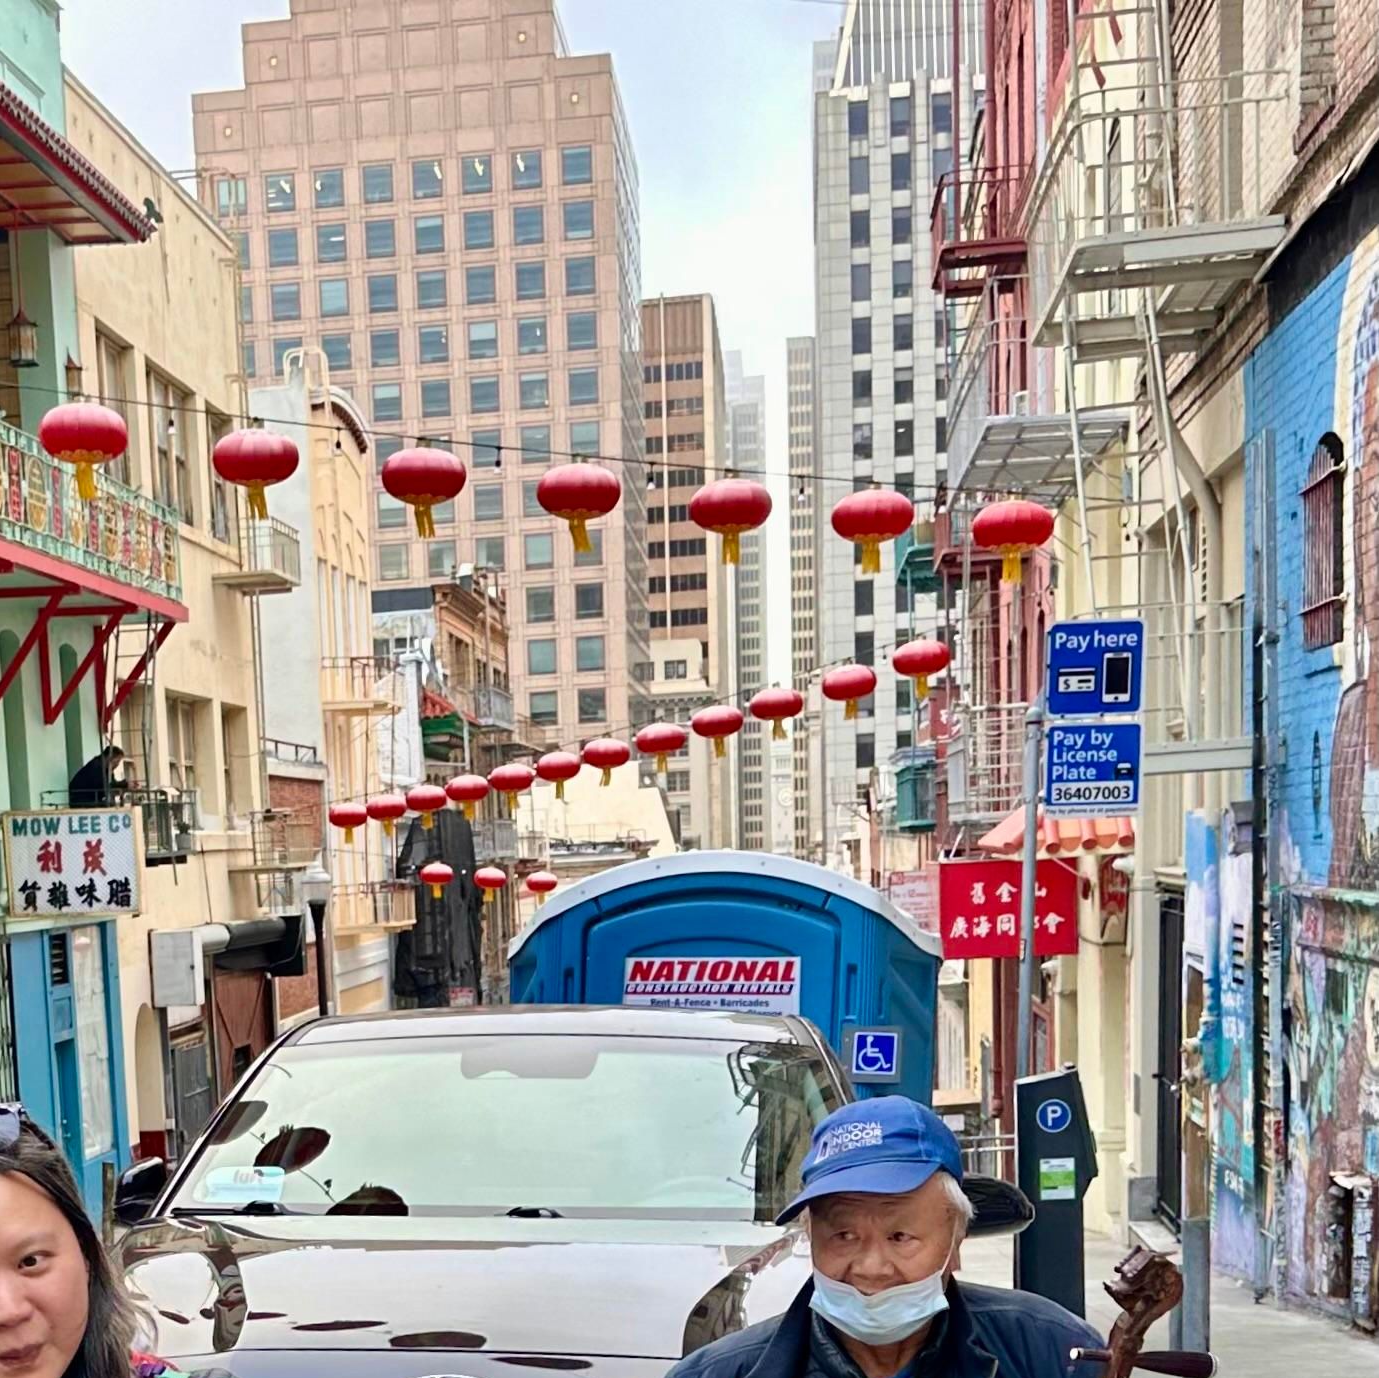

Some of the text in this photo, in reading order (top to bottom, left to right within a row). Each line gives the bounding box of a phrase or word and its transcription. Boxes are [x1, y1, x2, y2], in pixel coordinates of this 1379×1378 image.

[1055, 629, 1139, 653] Pay here
[1053, 728, 1114, 750] Pay by
[1052, 746, 1118, 764] License
[1051, 764, 1097, 781] Plate
[1053, 785, 1132, 802] 36407003
[12, 817, 61, 837] MOW
[68, 815, 101, 835] LEE
[628, 960, 797, 983] NATIONAL
[626, 983, 792, 994] CONSTRUCTION RENTALS
[650, 998, 770, 1009] Rent-A-Fence Barricades
[1046, 1105, 1063, 1127] P
[829, 1128, 883, 1147] INDOOR
[830, 1121, 883, 1137] NATIONAL
[842, 1136, 884, 1153] CENTERS
